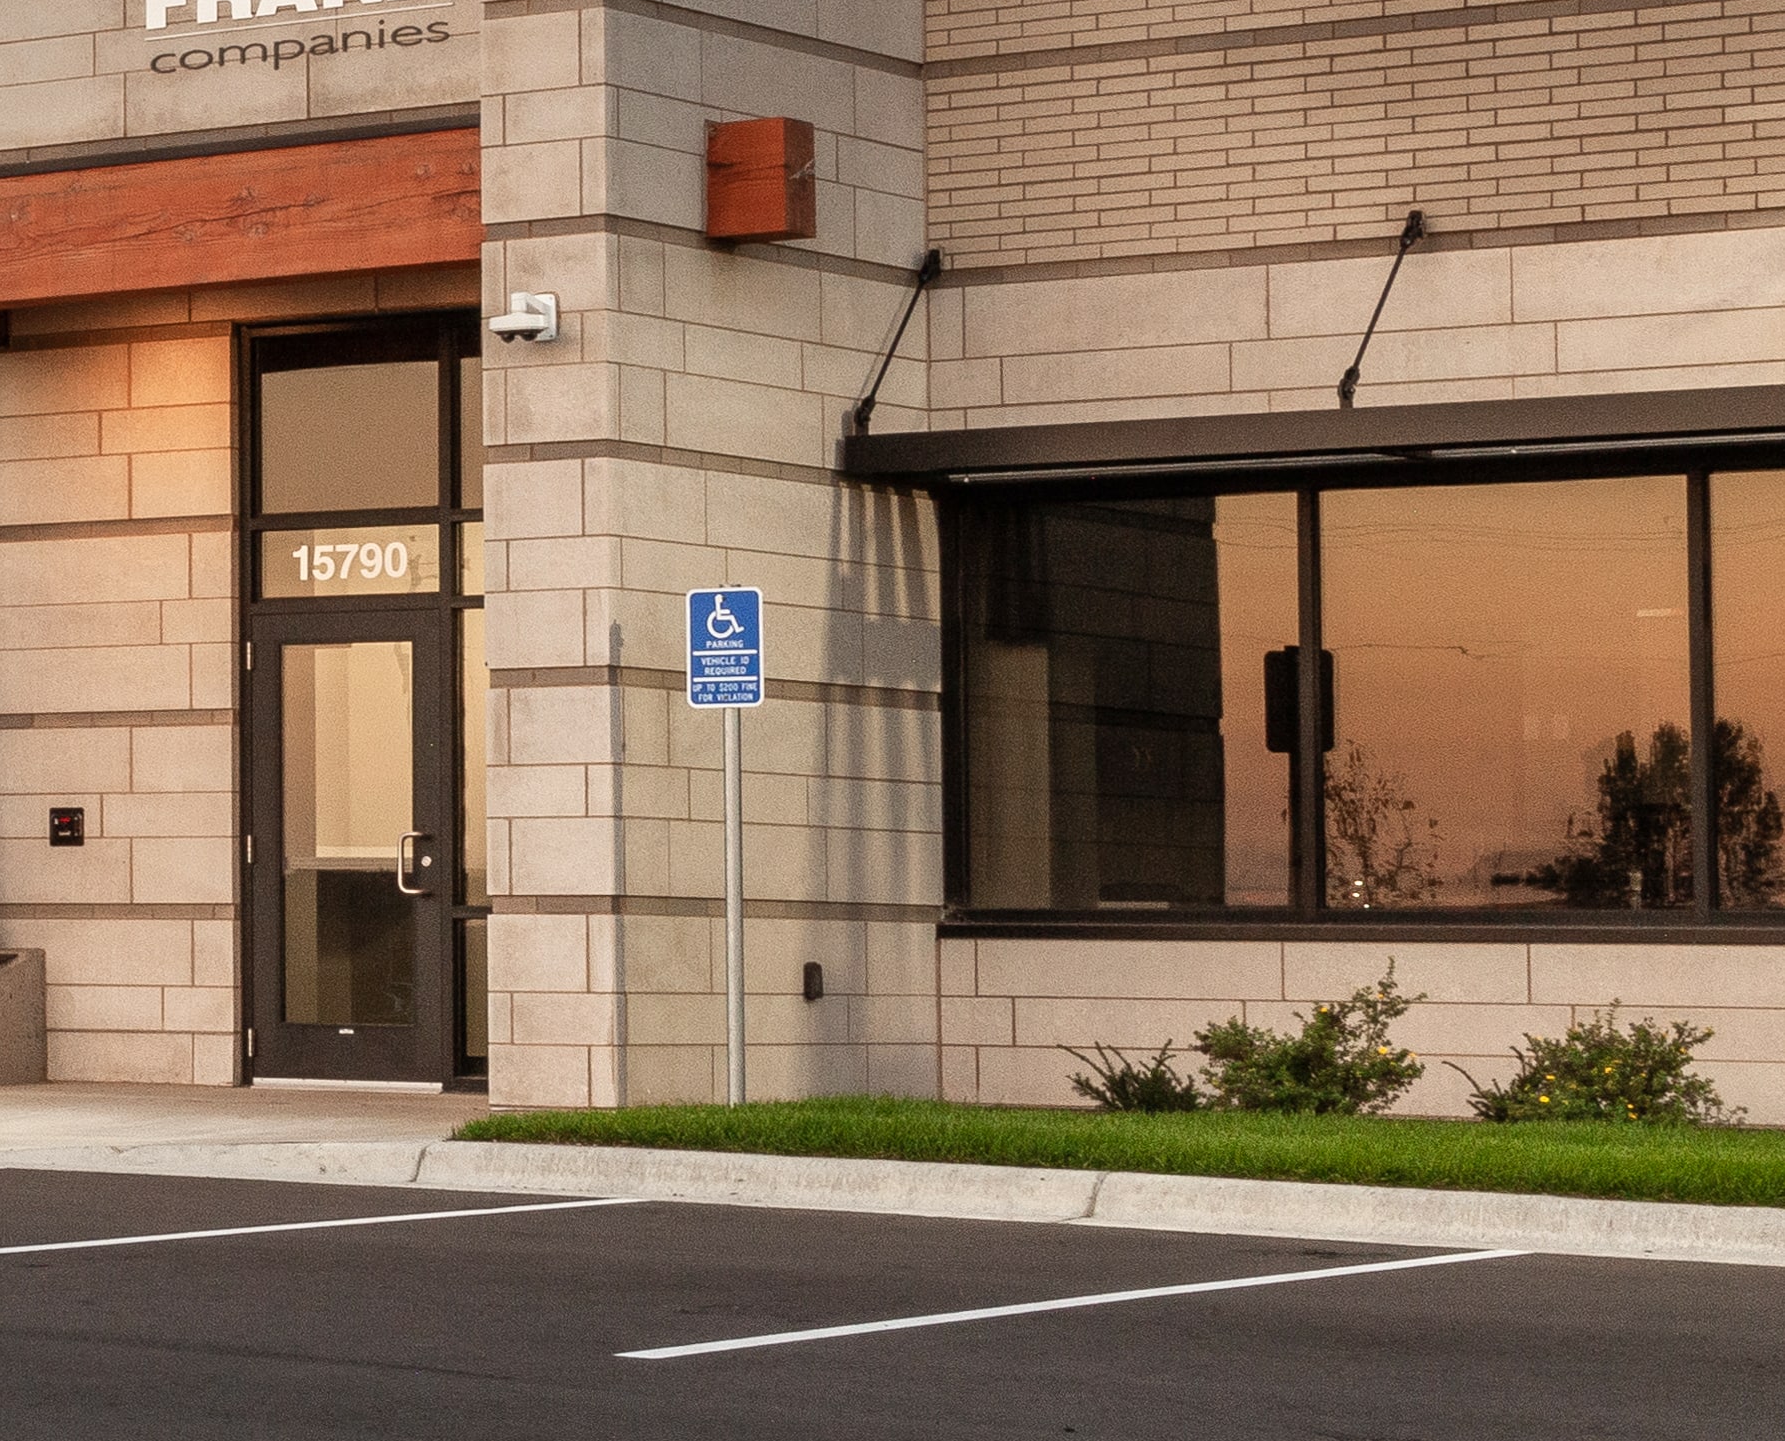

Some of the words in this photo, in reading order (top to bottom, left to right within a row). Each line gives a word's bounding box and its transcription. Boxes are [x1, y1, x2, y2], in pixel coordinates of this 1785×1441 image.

[149, 19, 452, 74] companies
[292, 541, 408, 581] 15790
[706, 640, 744, 648] PARKING
[701, 657, 736, 665] VEHICLE
[740, 656, 750, 665] ID
[704, 666, 747, 675] REQUIRED
[693, 683, 703, 692] UP
[706, 683, 716, 692] TO
[698, 693, 713, 702] FOR
